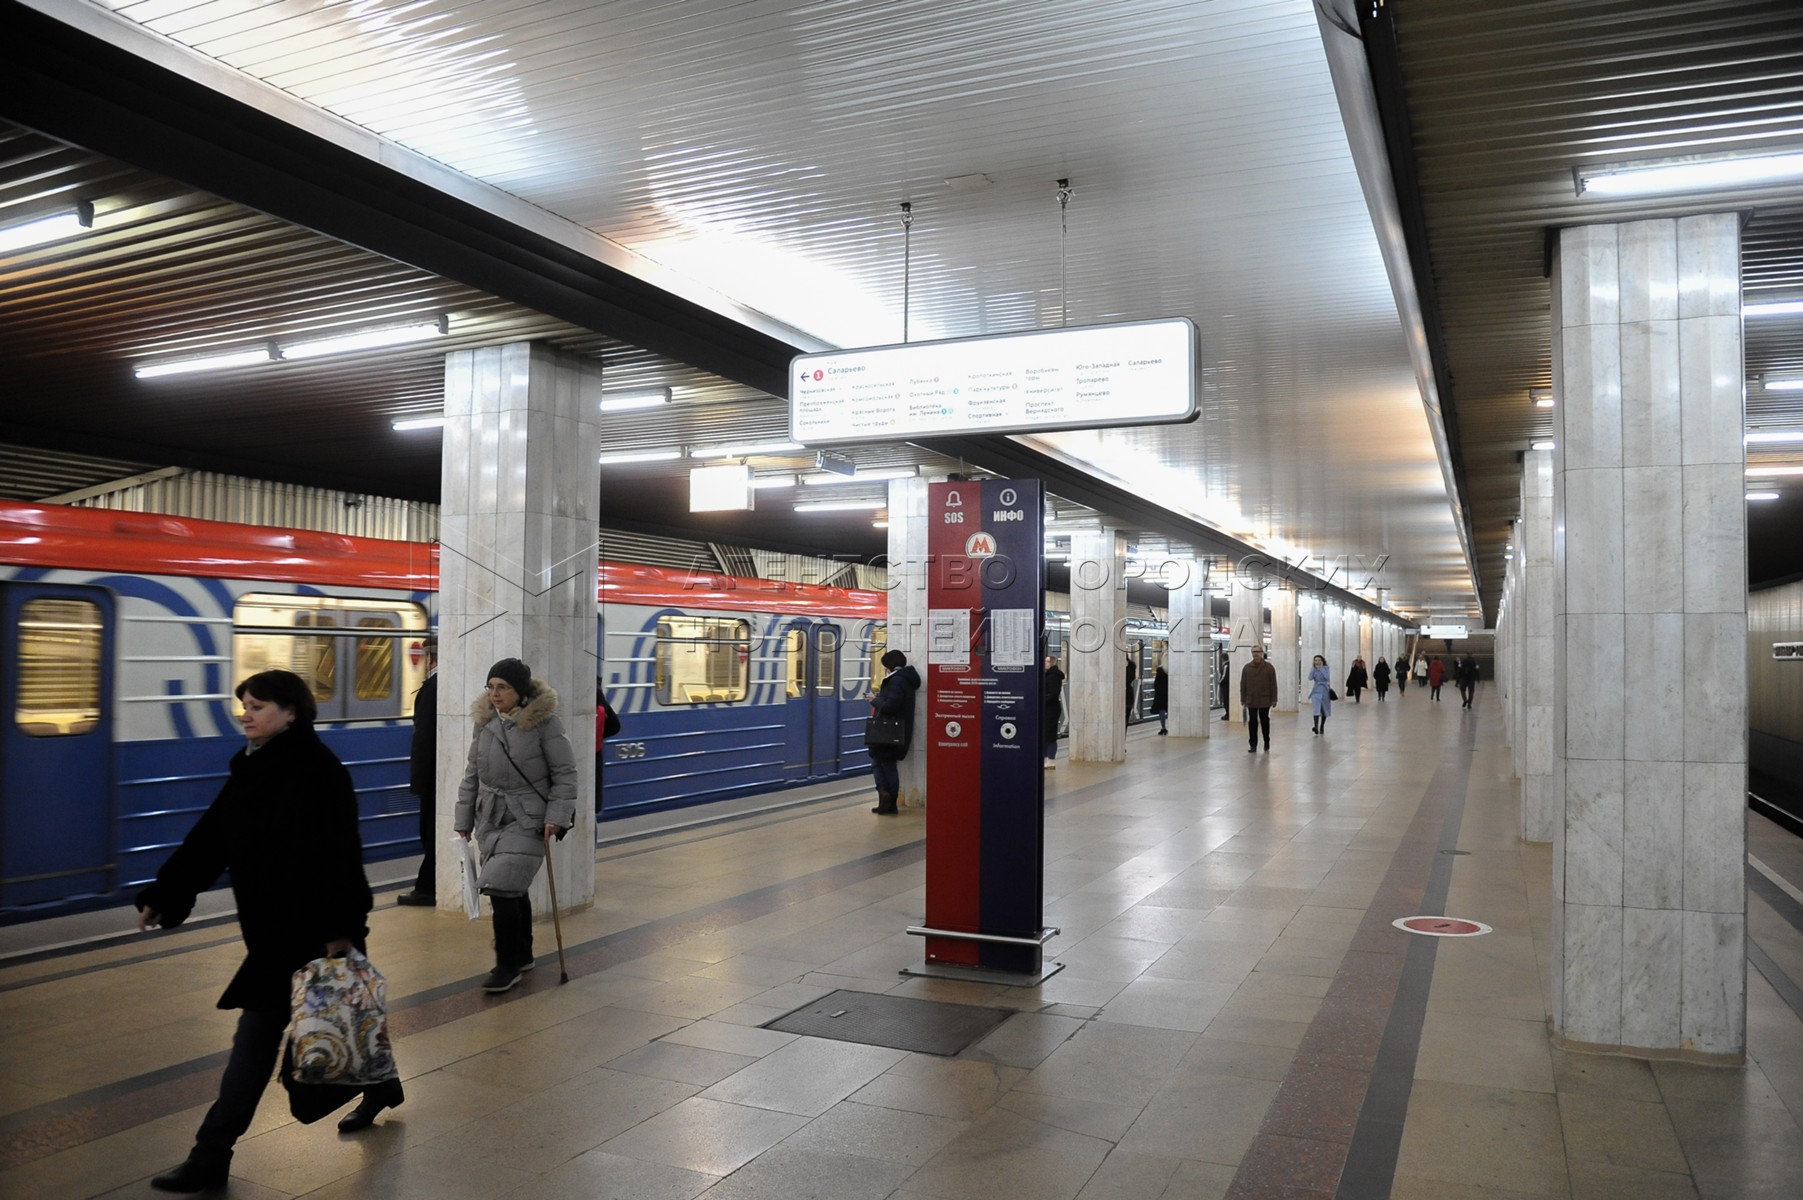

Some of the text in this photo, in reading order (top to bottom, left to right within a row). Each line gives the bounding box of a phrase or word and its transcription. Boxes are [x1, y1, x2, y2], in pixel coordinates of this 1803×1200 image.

[827, 365, 866, 375] Саларьево
[944, 511, 964, 524] SOS
[993, 510, 1024, 522] ИНФО
